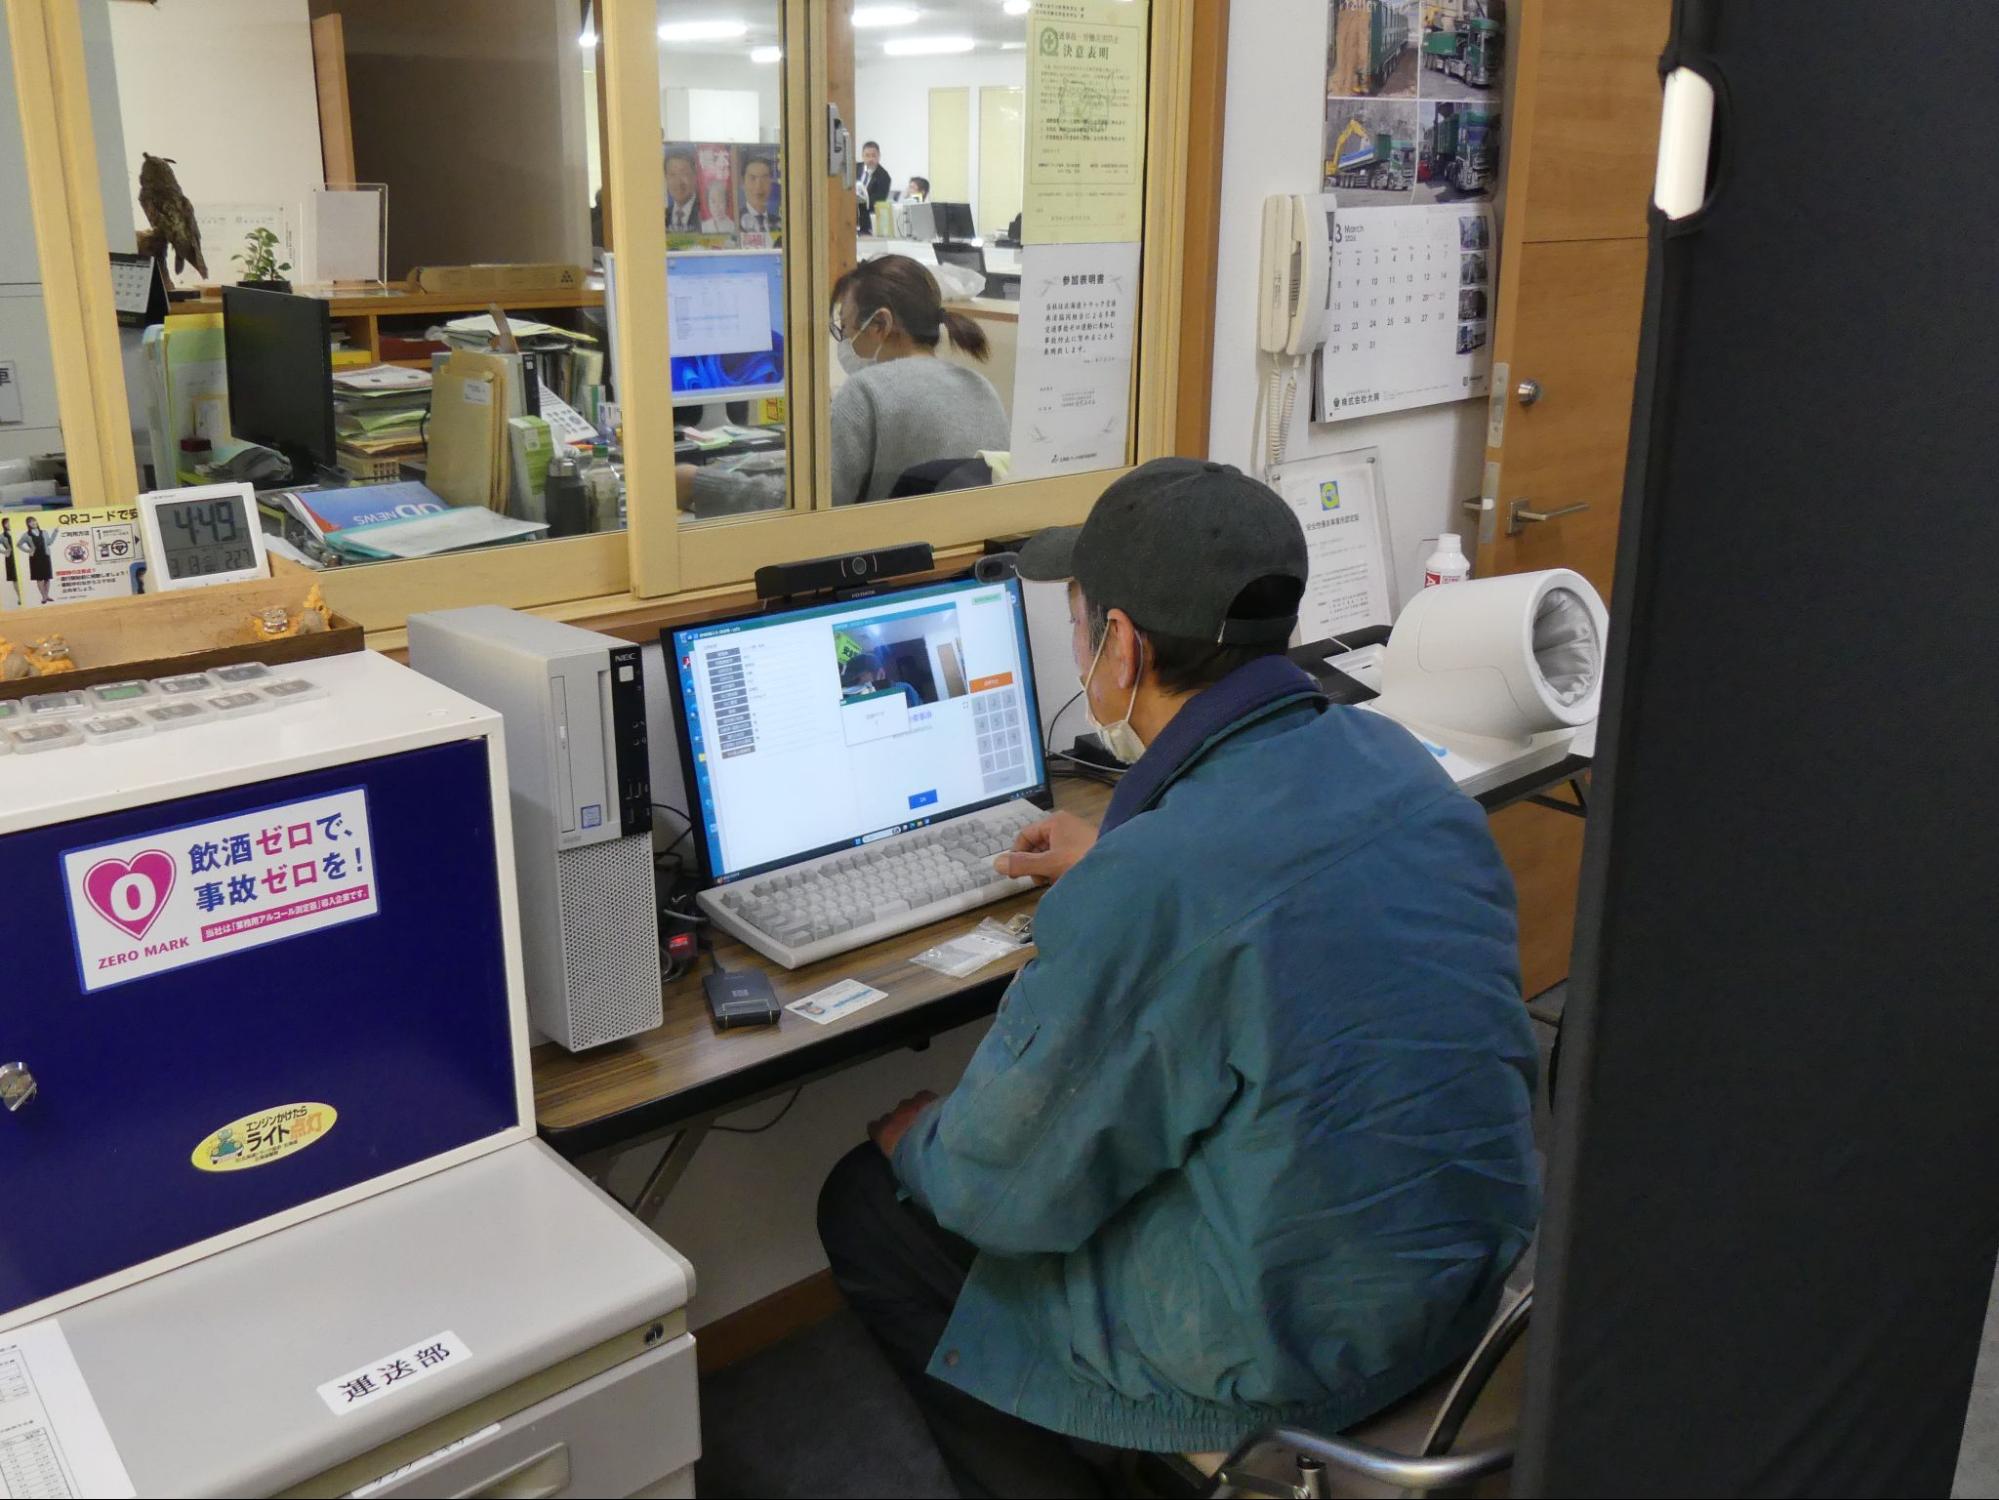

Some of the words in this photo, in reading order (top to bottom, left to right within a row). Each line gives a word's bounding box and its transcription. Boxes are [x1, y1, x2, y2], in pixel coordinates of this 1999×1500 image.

[1063, 43, 1109, 60] 決意表明
[1335, 223, 1343, 243] 3
[1345, 224, 1364, 233] March
[1062, 273, 1105, 286] 参加表明書
[353, 511, 398, 525] NEWS
[615, 652, 637, 663] NEC
[188, 811, 353, 875] 飲酒ゼロで、
[194, 847, 364, 913] 事故ゼロを!
[98, 949, 139, 970] ZERO
[144, 936, 190, 957] MARK
[246, 1105, 308, 1133] エンジンかけたら
[337, 1343, 450, 1403] 運送部
